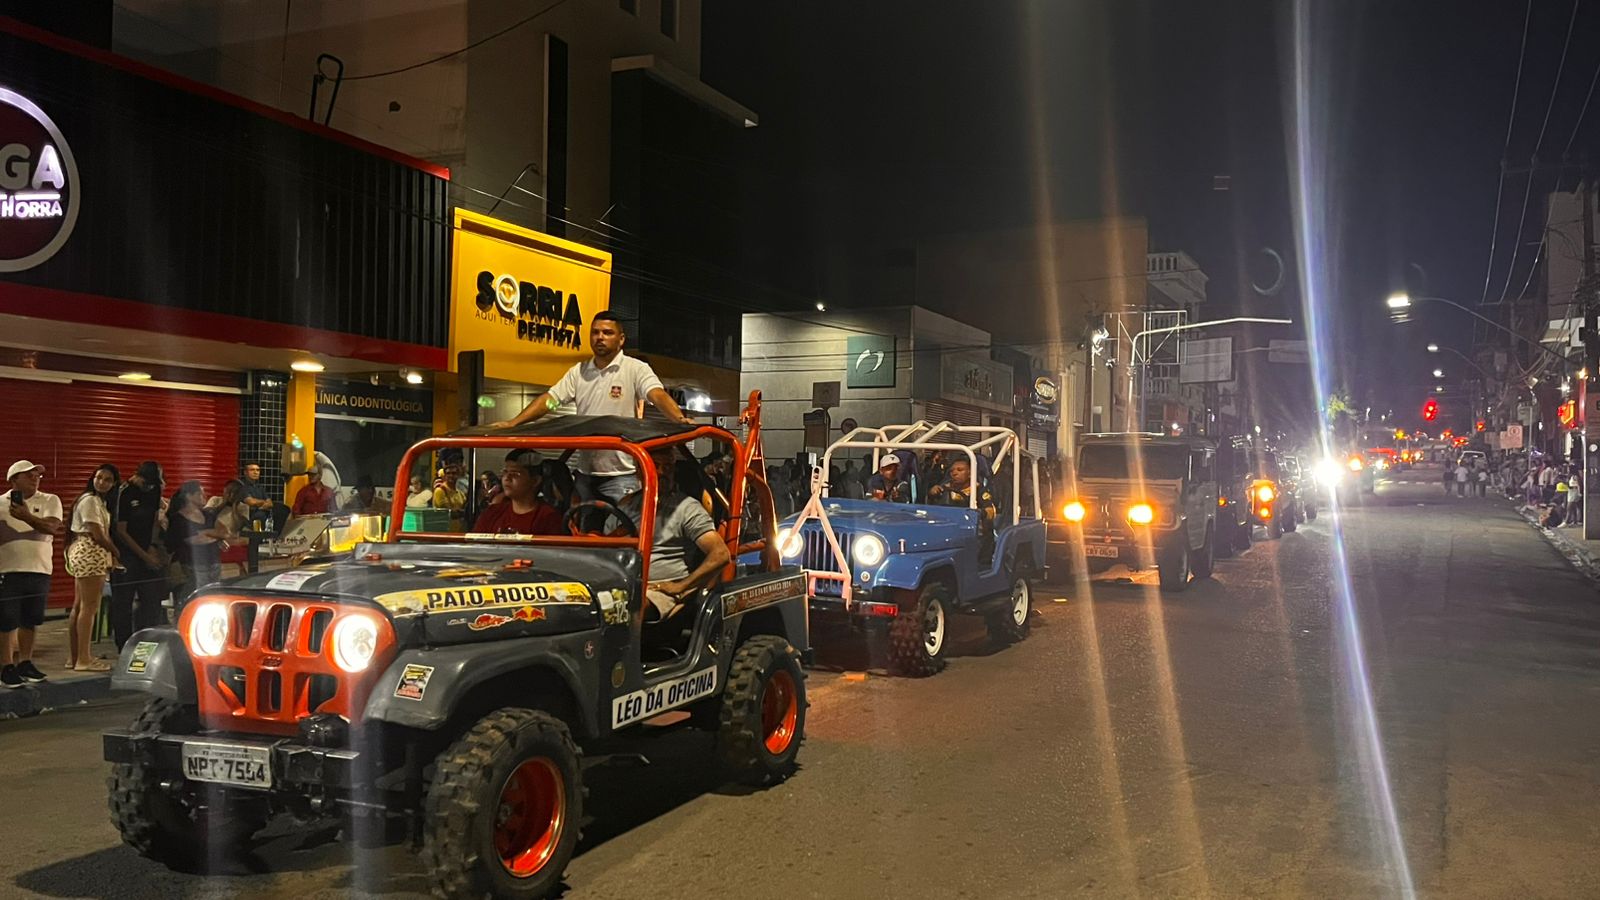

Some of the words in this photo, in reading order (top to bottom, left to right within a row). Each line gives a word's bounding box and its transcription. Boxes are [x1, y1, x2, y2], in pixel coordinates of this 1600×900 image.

[0, 143, 64, 190] GA
[0, 197, 63, 217] HORRA
[476, 271, 582, 326] SORRIA
[475, 309, 497, 324] AQUI
[499, 314, 516, 327] TEM
[518, 319, 581, 350] DENTISTA
[315, 390, 347, 407] LÍNICA
[350, 395, 424, 413] ODONTOLÓGICA
[427, 588, 484, 609] PATO
[492, 585, 550, 604] ROCO
[616, 694, 643, 724] LÉO
[645, 687, 664, 713] DA
[668, 671, 714, 705] OFICINA
